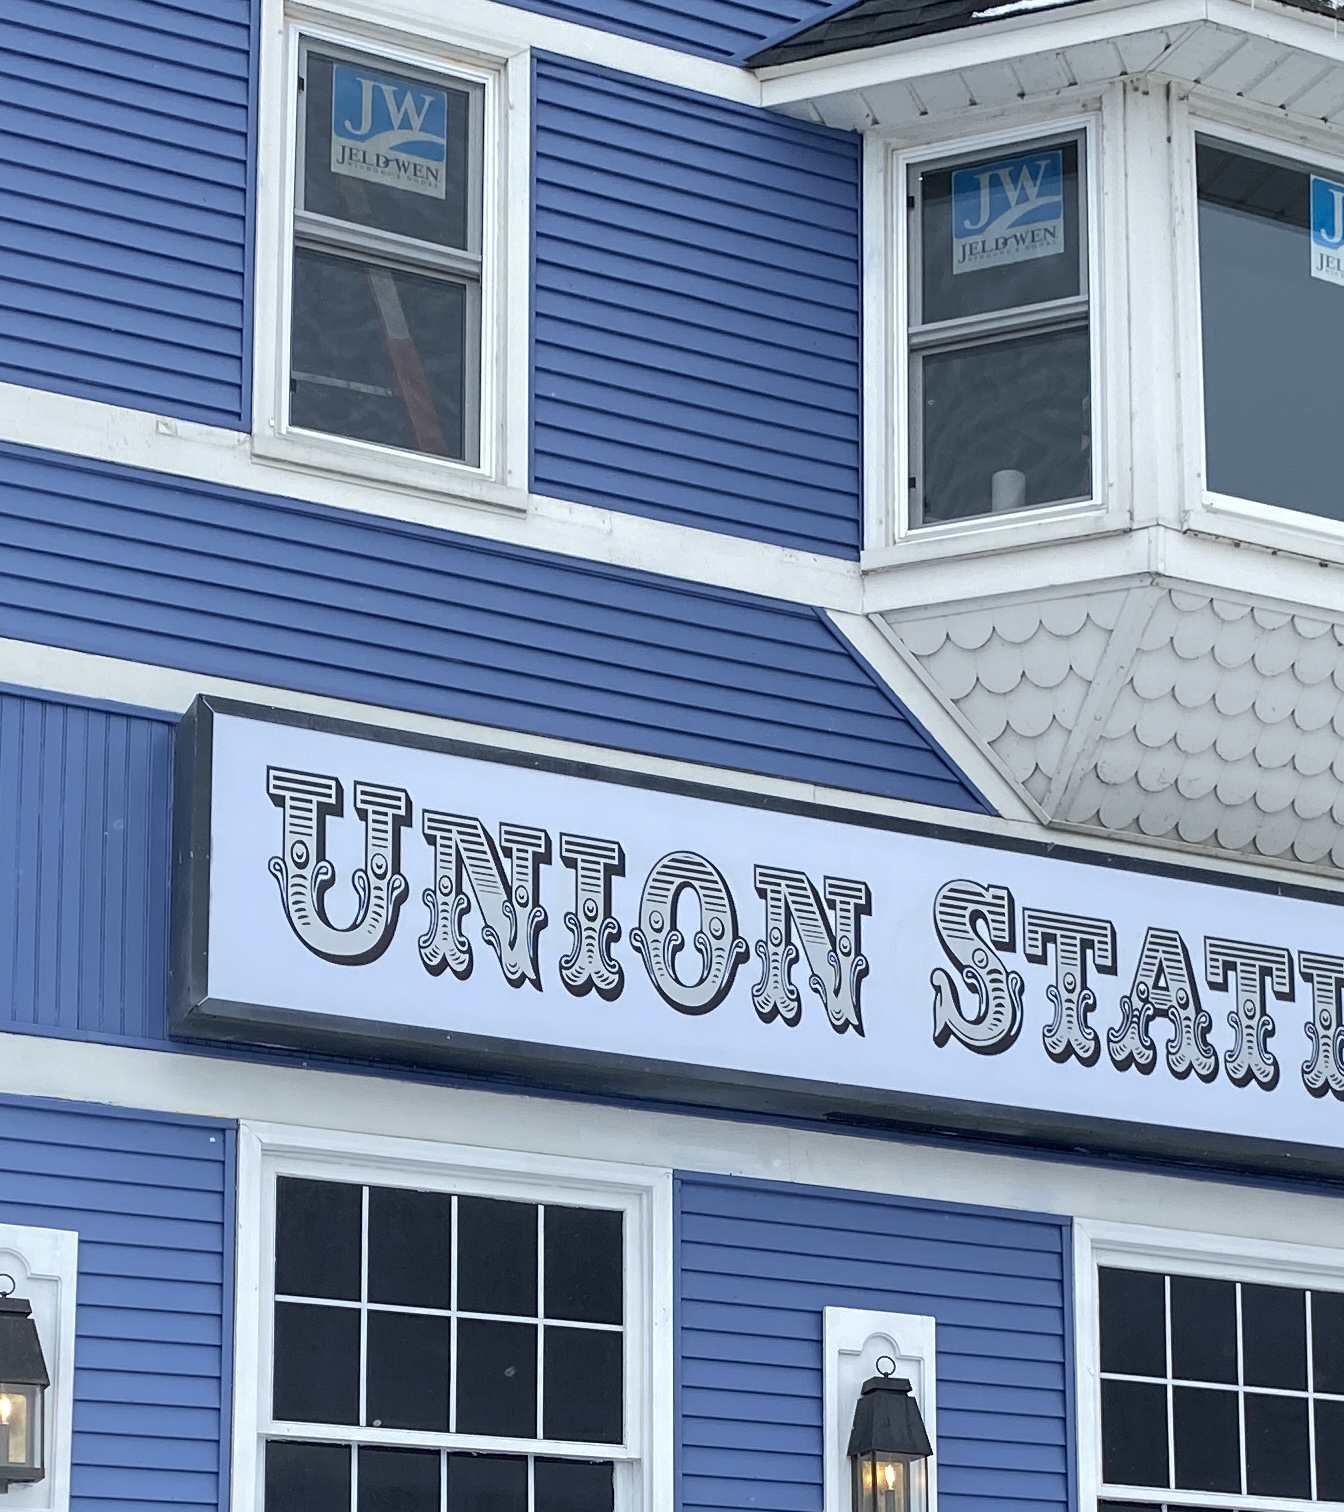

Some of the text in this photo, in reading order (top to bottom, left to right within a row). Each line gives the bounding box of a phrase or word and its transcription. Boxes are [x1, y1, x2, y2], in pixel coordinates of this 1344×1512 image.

[344, 77, 435, 135] JW
[964, 159, 1051, 230] JW
[266, 765, 871, 1037] UNION
